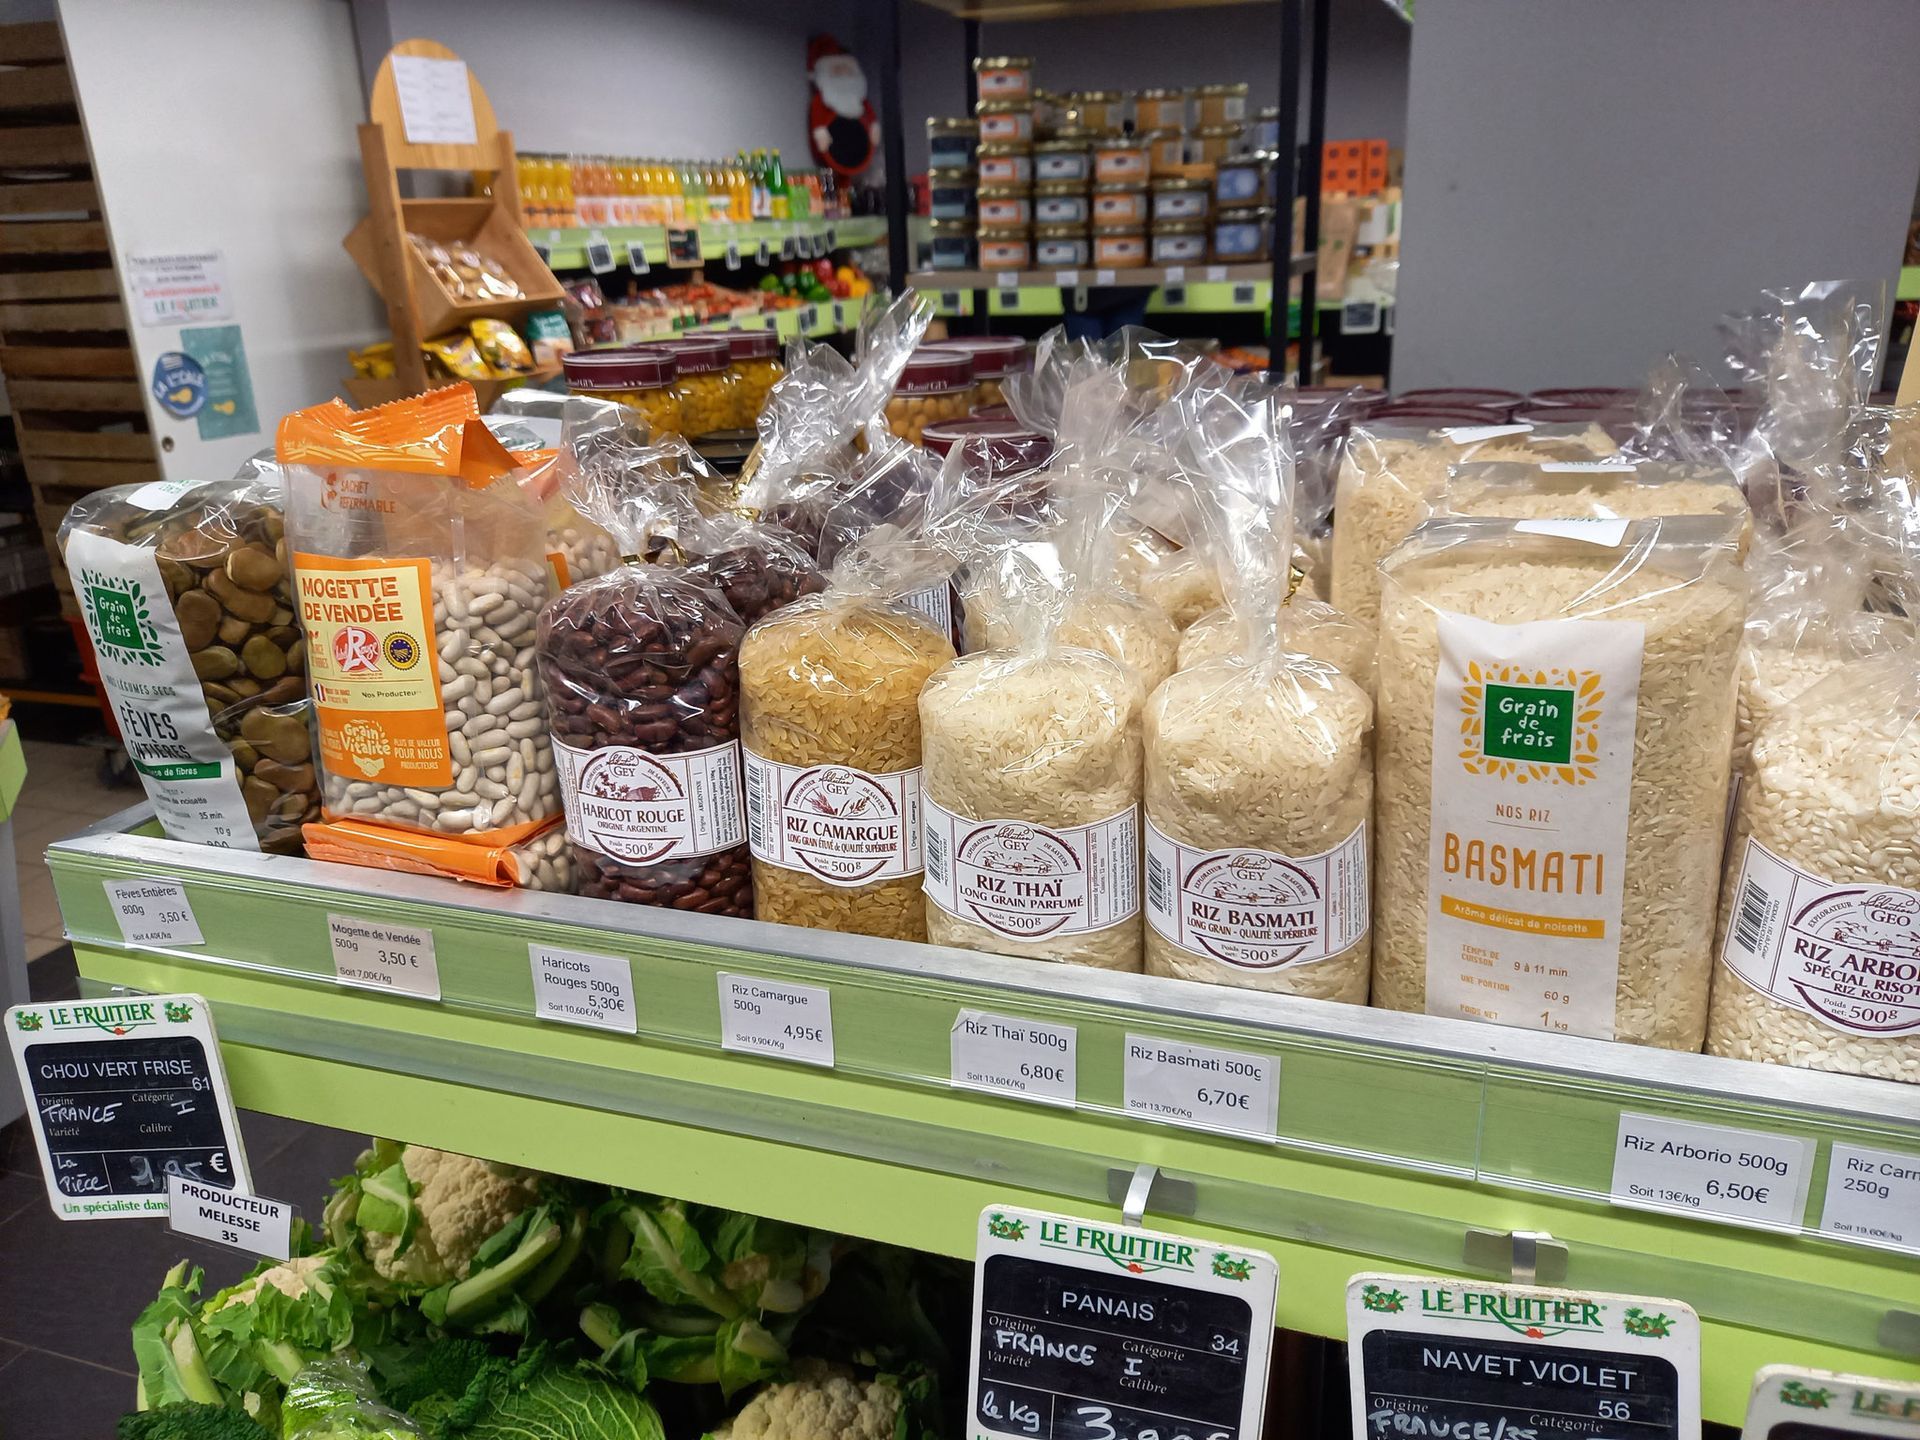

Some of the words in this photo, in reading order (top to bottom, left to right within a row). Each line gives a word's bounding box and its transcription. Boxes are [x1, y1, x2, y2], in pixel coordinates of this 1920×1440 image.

[302, 576, 399, 599] MOGETTE
[99, 596, 127, 613] Grain
[304, 601, 321, 620] DE
[325, 596, 404, 623] VENDÉE
[109, 612, 121, 623] de
[106, 621, 131, 638] frais
[1499, 696, 1559, 719] Grain
[119, 701, 179, 741] FÈVES
[344, 723, 379, 739] Grain
[1519, 717, 1539, 730] de
[131, 739, 192, 760] ENTIÈRES
[340, 730, 391, 756] Vitalité
[1501, 729, 1555, 749] frais
[394, 748, 415, 759] POUR
[418, 748, 443, 760] NOUS
[176, 767, 198, 776] fibres
[613, 766, 636, 778] GEY
[826, 784, 850, 796] GEY
[582, 802, 632, 822] HARICOT
[637, 809, 686, 824] ROUGE
[1495, 803, 1523, 820] NOS
[1529, 808, 1551, 823] RIZ
[597, 820, 624, 832] ORIGINE
[626, 824, 668, 834] ARGENTINE
[786, 816, 808, 833] RIZ
[813, 821, 898, 841] CAMARGUE
[787, 833, 801, 843] LONG
[802, 835, 818, 847] GRAIN
[1002, 840, 1030, 852] GEY
[1443, 832, 1605, 895] BASMATI
[977, 874, 1006, 894] RIZ
[1013, 878, 1063, 898] THAÏ
[1236, 870, 1266, 881] GEY
[115, 888, 142, 899] Fèves
[142, 886, 178, 898] Entières
[959, 885, 988, 901] LONG
[991, 893, 1026, 908] GRAIN
[1030, 894, 1084, 909] PARFUMÉ
[121, 904, 145, 916] 800g
[158, 911, 180, 924] 3,50
[181, 911, 189, 922] €
[1191, 901, 1220, 921] RIZ
[1228, 909, 1315, 928] BASMATI
[1453, 904, 1486, 919] Arôme
[1489, 911, 1525, 928] délicat
[1527, 918, 1541, 930] de
[1543, 922, 1588, 933] noisette
[1808, 901, 1853, 928] EXPLORATEUR
[1870, 909, 1911, 927] GEO
[331, 922, 370, 940] Mogette
[371, 929, 383, 940] de
[384, 929, 421, 946] Vendée
[1187, 916, 1208, 930] LONG
[1208, 923, 1232, 936] GRAIN
[1239, 928, 1272, 940] QUALITÉ
[1273, 926, 1319, 941] SUPÉRIEURE
[335, 937, 358, 952] 500g
[1794, 936, 1833, 964] RIZ
[378, 950, 407, 968] 3,50
[410, 954, 419, 968] €
[541, 955, 591, 973] Haricots
[1513, 961, 1521, 972] 9
[1534, 964, 1546, 975] 11
[339, 966, 355, 978] Soit
[1803, 961, 1868, 987] SPÉCIAL
[544, 972, 587, 990] Rouges
[590, 979, 620, 997] 500g
[731, 983, 749, 996] Riz
[751, 986, 808, 1006] Camargue
[1834, 983, 1856, 995] RIZ
[1861, 989, 1905, 1004] ROND
[548, 1001, 564, 1013] Soit
[588, 994, 625, 1013] 5,30€
[733, 999, 761, 1015] 500g
[1544, 989, 1559, 1002] 60
[1562, 993, 1570, 1005] g
[1823, 997, 1847, 1008] Poids
[49, 1008, 70, 1026] LE
[74, 1002, 156, 1027] FRUITIER
[1540, 1011, 1550, 1027] 1
[1554, 1019, 1568, 1031] kg
[736, 1033, 751, 1044] Soit
[783, 1024, 823, 1043] 4,95€
[965, 1020, 988, 1036] Riz
[992, 1023, 1025, 1042] Thaï
[1029, 1030, 1068, 1052] 500g
[1130, 1045, 1153, 1061] Riz
[1157, 1049, 1220, 1072] Basmati
[41, 1063, 91, 1080] CHOU
[93, 1061, 138, 1078] VERT
[143, 1059, 194, 1076] FRISE
[1020, 1062, 1065, 1083] 6,80€
[191, 1076, 210, 1092] 61
[966, 1071, 983, 1082] Soit
[985, 1074, 1026, 1090] 13,60€/Kg
[41, 1096, 74, 1107] Origine
[131, 1092, 175, 1103] Catégorie
[1130, 1099, 1148, 1110] Soit
[1197, 1087, 1251, 1110] 6,70€
[41, 1102, 123, 1124] FRANCE
[139, 1123, 173, 1134] Calibre
[1623, 1135, 1655, 1153] Riz
[1660, 1140, 1732, 1164] Arborio
[1738, 1152, 1789, 1176] 500g
[1847, 1157, 1875, 1174] Riz
[1629, 1183, 1655, 1198] Soit
[1658, 1189, 1701, 1207] 13€/kg
[1705, 1179, 1771, 1204] 6,50€
[1843, 1177, 1891, 1199] 250g
[63, 1202, 80, 1214] Un
[83, 1200, 140, 1215] spécialiste
[143, 1199, 168, 1211] dans
[181, 1183, 279, 1219] PRODUCTEUR
[198, 1206, 261, 1233] MELESSE
[1833, 1221, 1852, 1232] Soit
[221, 1229, 239, 1243] 35
[1040, 1221, 1067, 1244] LE
[1076, 1227, 1195, 1267] FRUITIER
[1062, 1291, 1154, 1322] PANAIS
[1421, 1288, 1454, 1314] LE
[1463, 1292, 1604, 1330] FRUITIER
[988, 1315, 1036, 1333] Origine
[1122, 1340, 1185, 1362] Catégorie
[1212, 1334, 1239, 1355] 34
[995, 1329, 1097, 1367] FRANCE
[1123, 1357, 1143, 1376] I
[987, 1350, 1031, 1369] Variété
[1119, 1376, 1168, 1395] Calibre
[1423, 1348, 1521, 1377] NAVET
[1531, 1360, 1638, 1391] VIOLET
[981, 1390, 1003, 1420] le
[1374, 1397, 1429, 1414] Origine
[1529, 1414, 1604, 1433] Catégorie
[1598, 1400, 1631, 1421] 56
